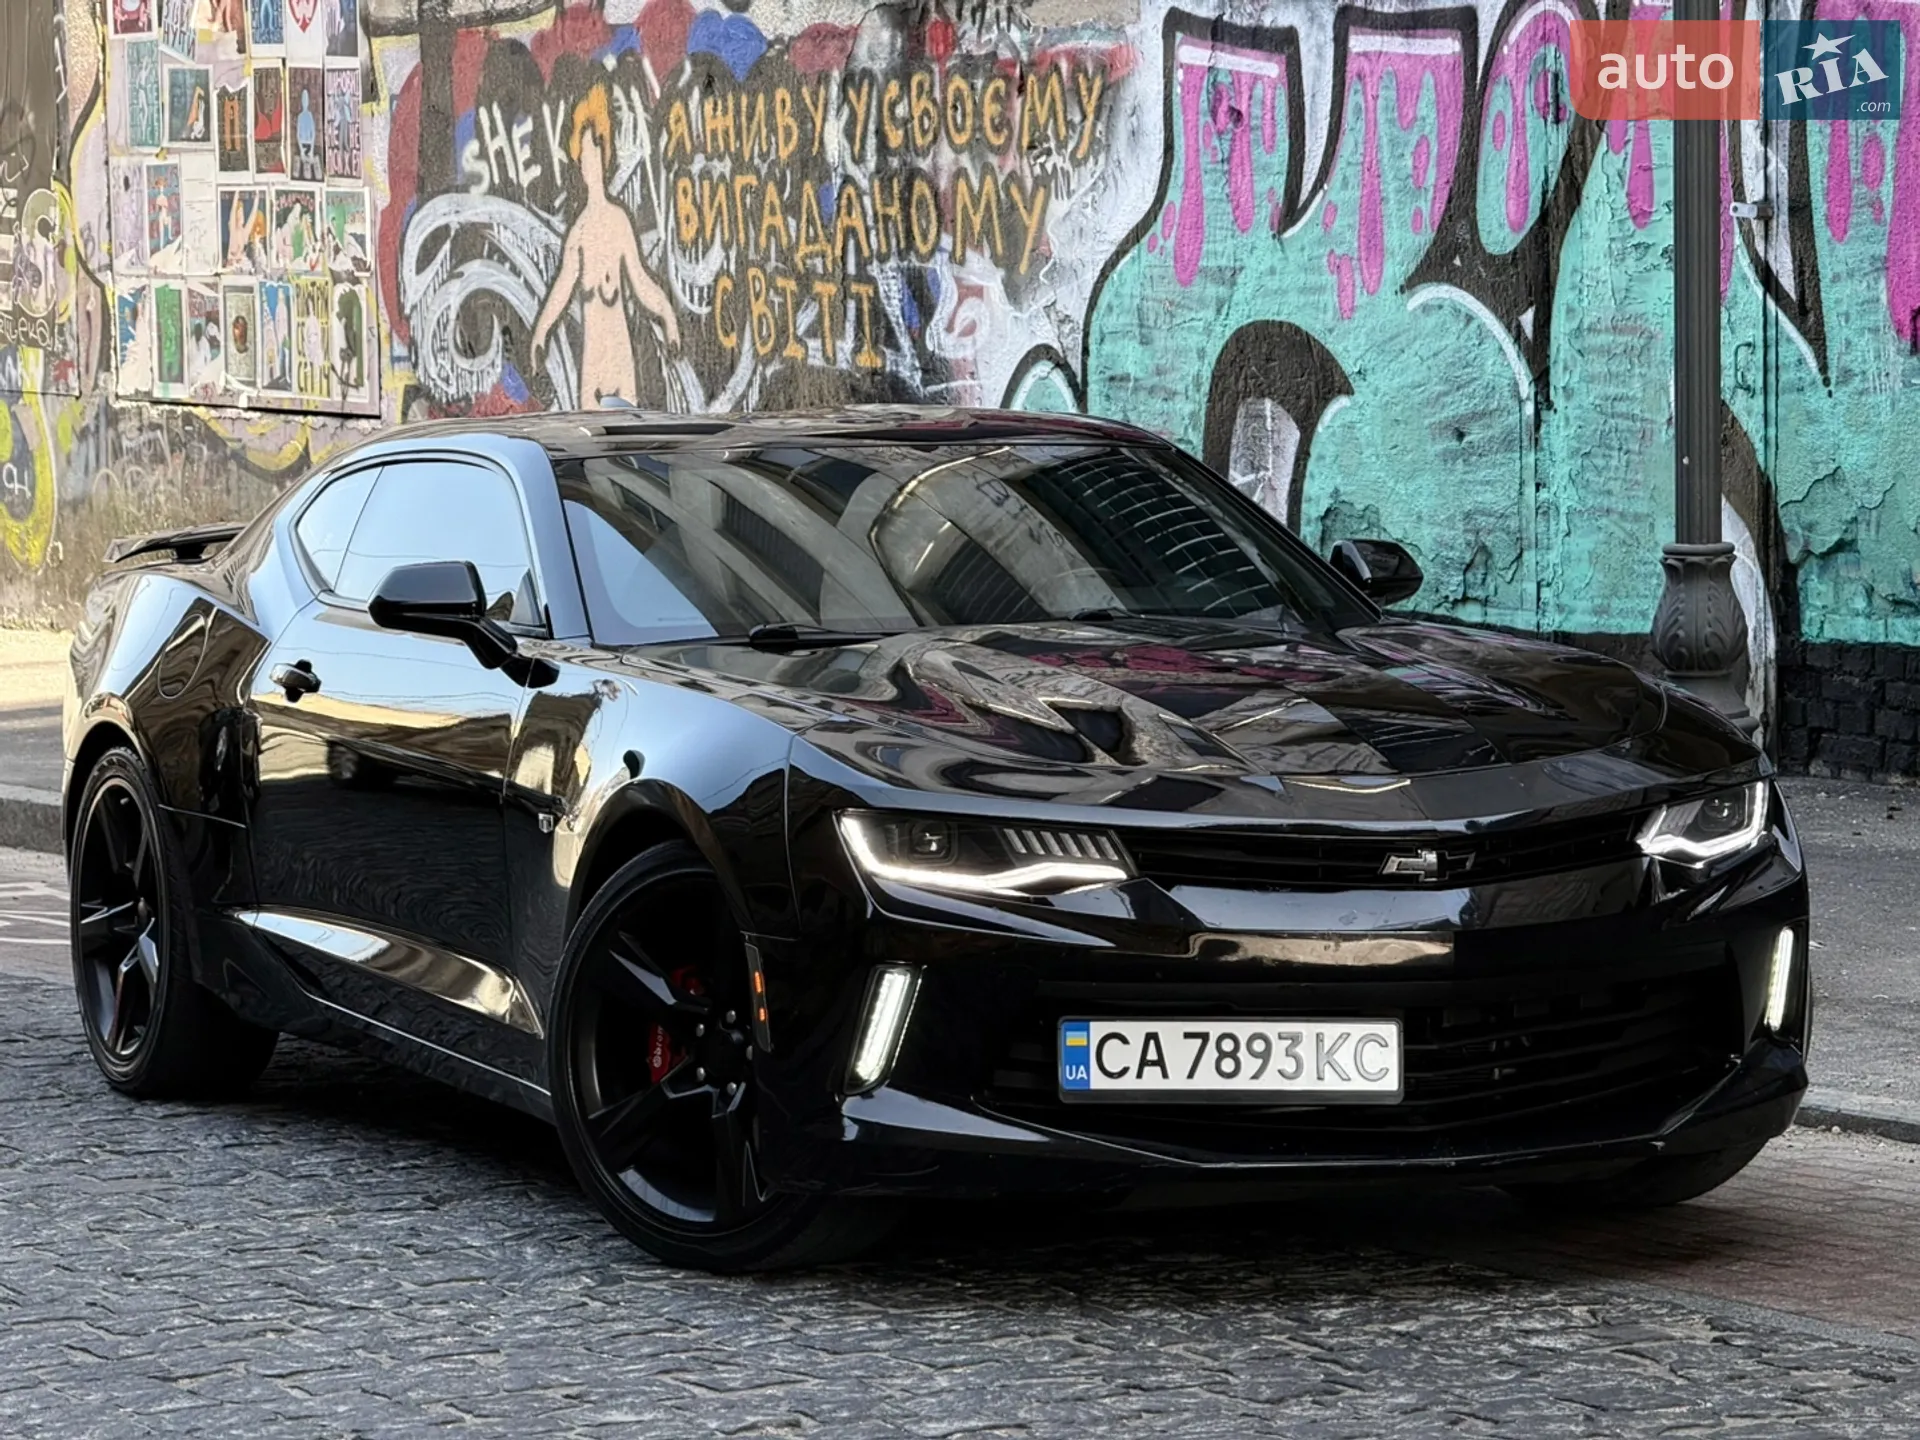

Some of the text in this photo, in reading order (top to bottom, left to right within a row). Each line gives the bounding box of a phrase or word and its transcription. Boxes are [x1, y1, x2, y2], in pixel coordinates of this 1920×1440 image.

[667, 101, 691, 158] Я
[704, 82, 824, 163] ЖИВУ
[882, 70, 1105, 160] СВОЄМУ
[675, 170, 1046, 275] ВИГАДАНОМУ
[714, 266, 883, 368] СВІТІ
[1066, 1064, 1088, 1080] UA
[1095, 1031, 1390, 1082] CA 7893 KC
